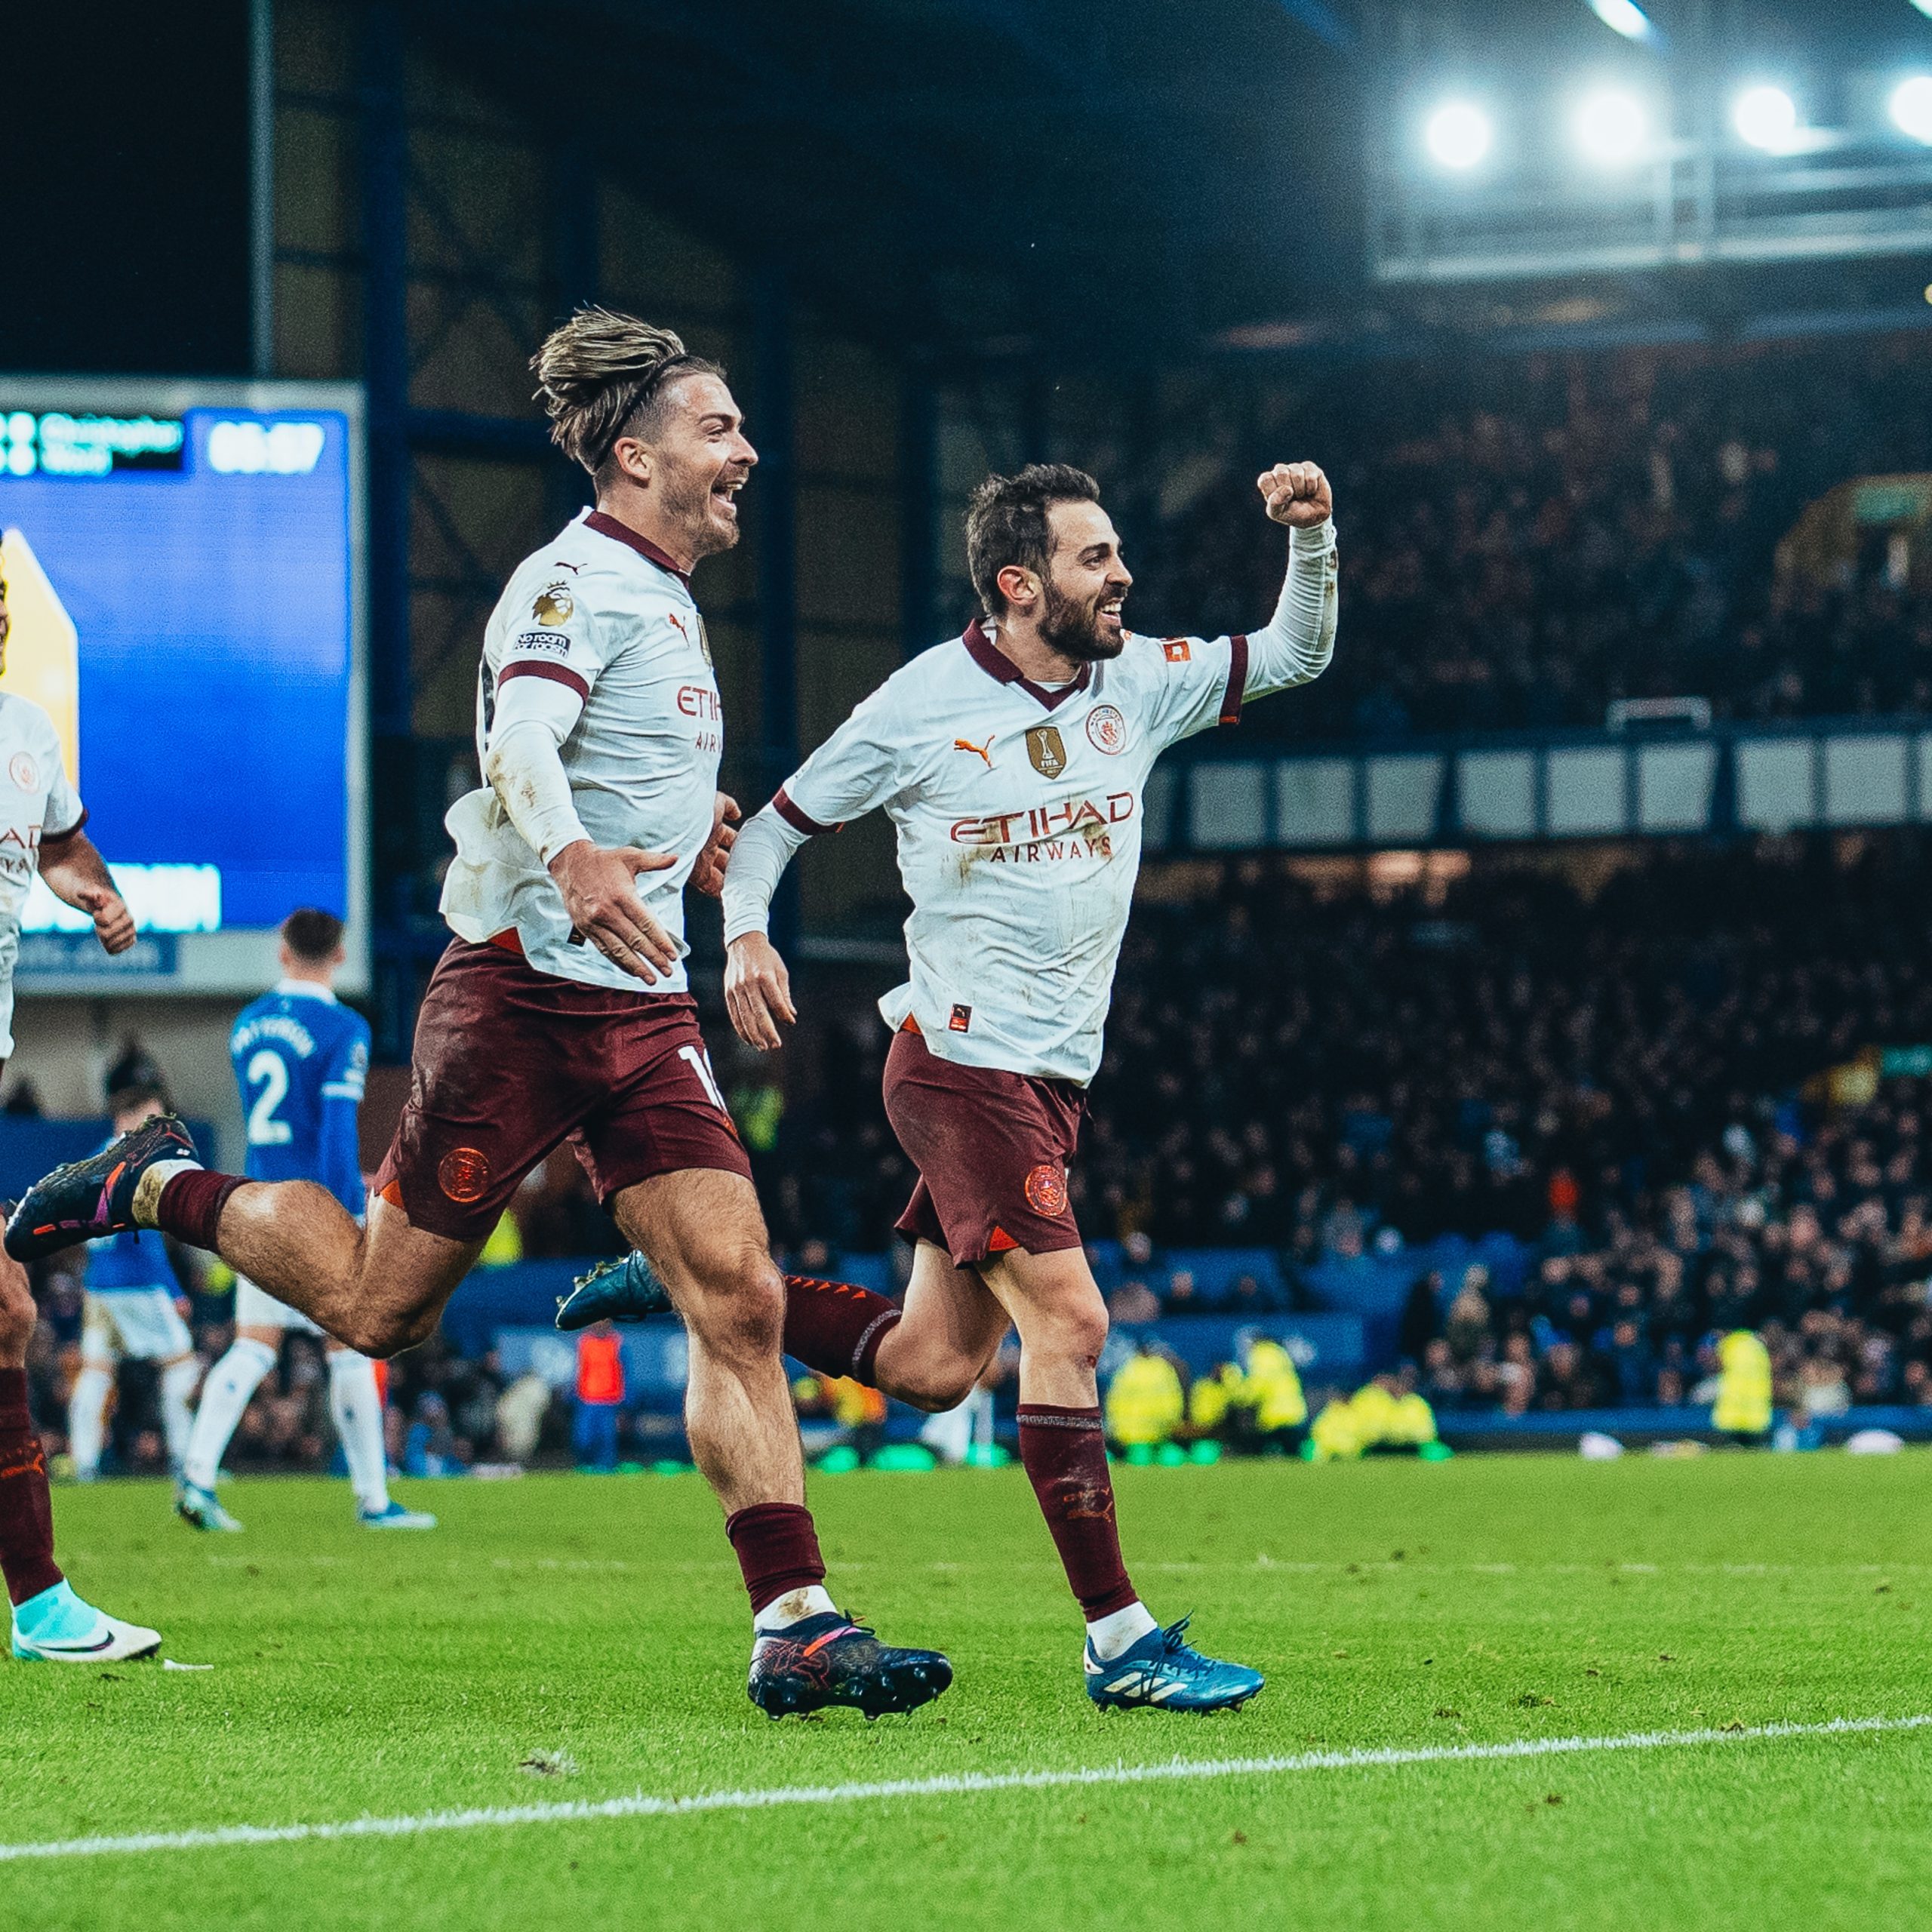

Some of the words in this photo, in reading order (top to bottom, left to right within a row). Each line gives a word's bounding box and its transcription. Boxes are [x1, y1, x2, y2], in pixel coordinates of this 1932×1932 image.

[534, 633, 567, 648] room
[694, 731, 722, 753] AIR
[950, 792, 1134, 844] ETIHAD
[990, 836, 1113, 863] AIRWAYS
[248, 1049, 293, 1145] 2
